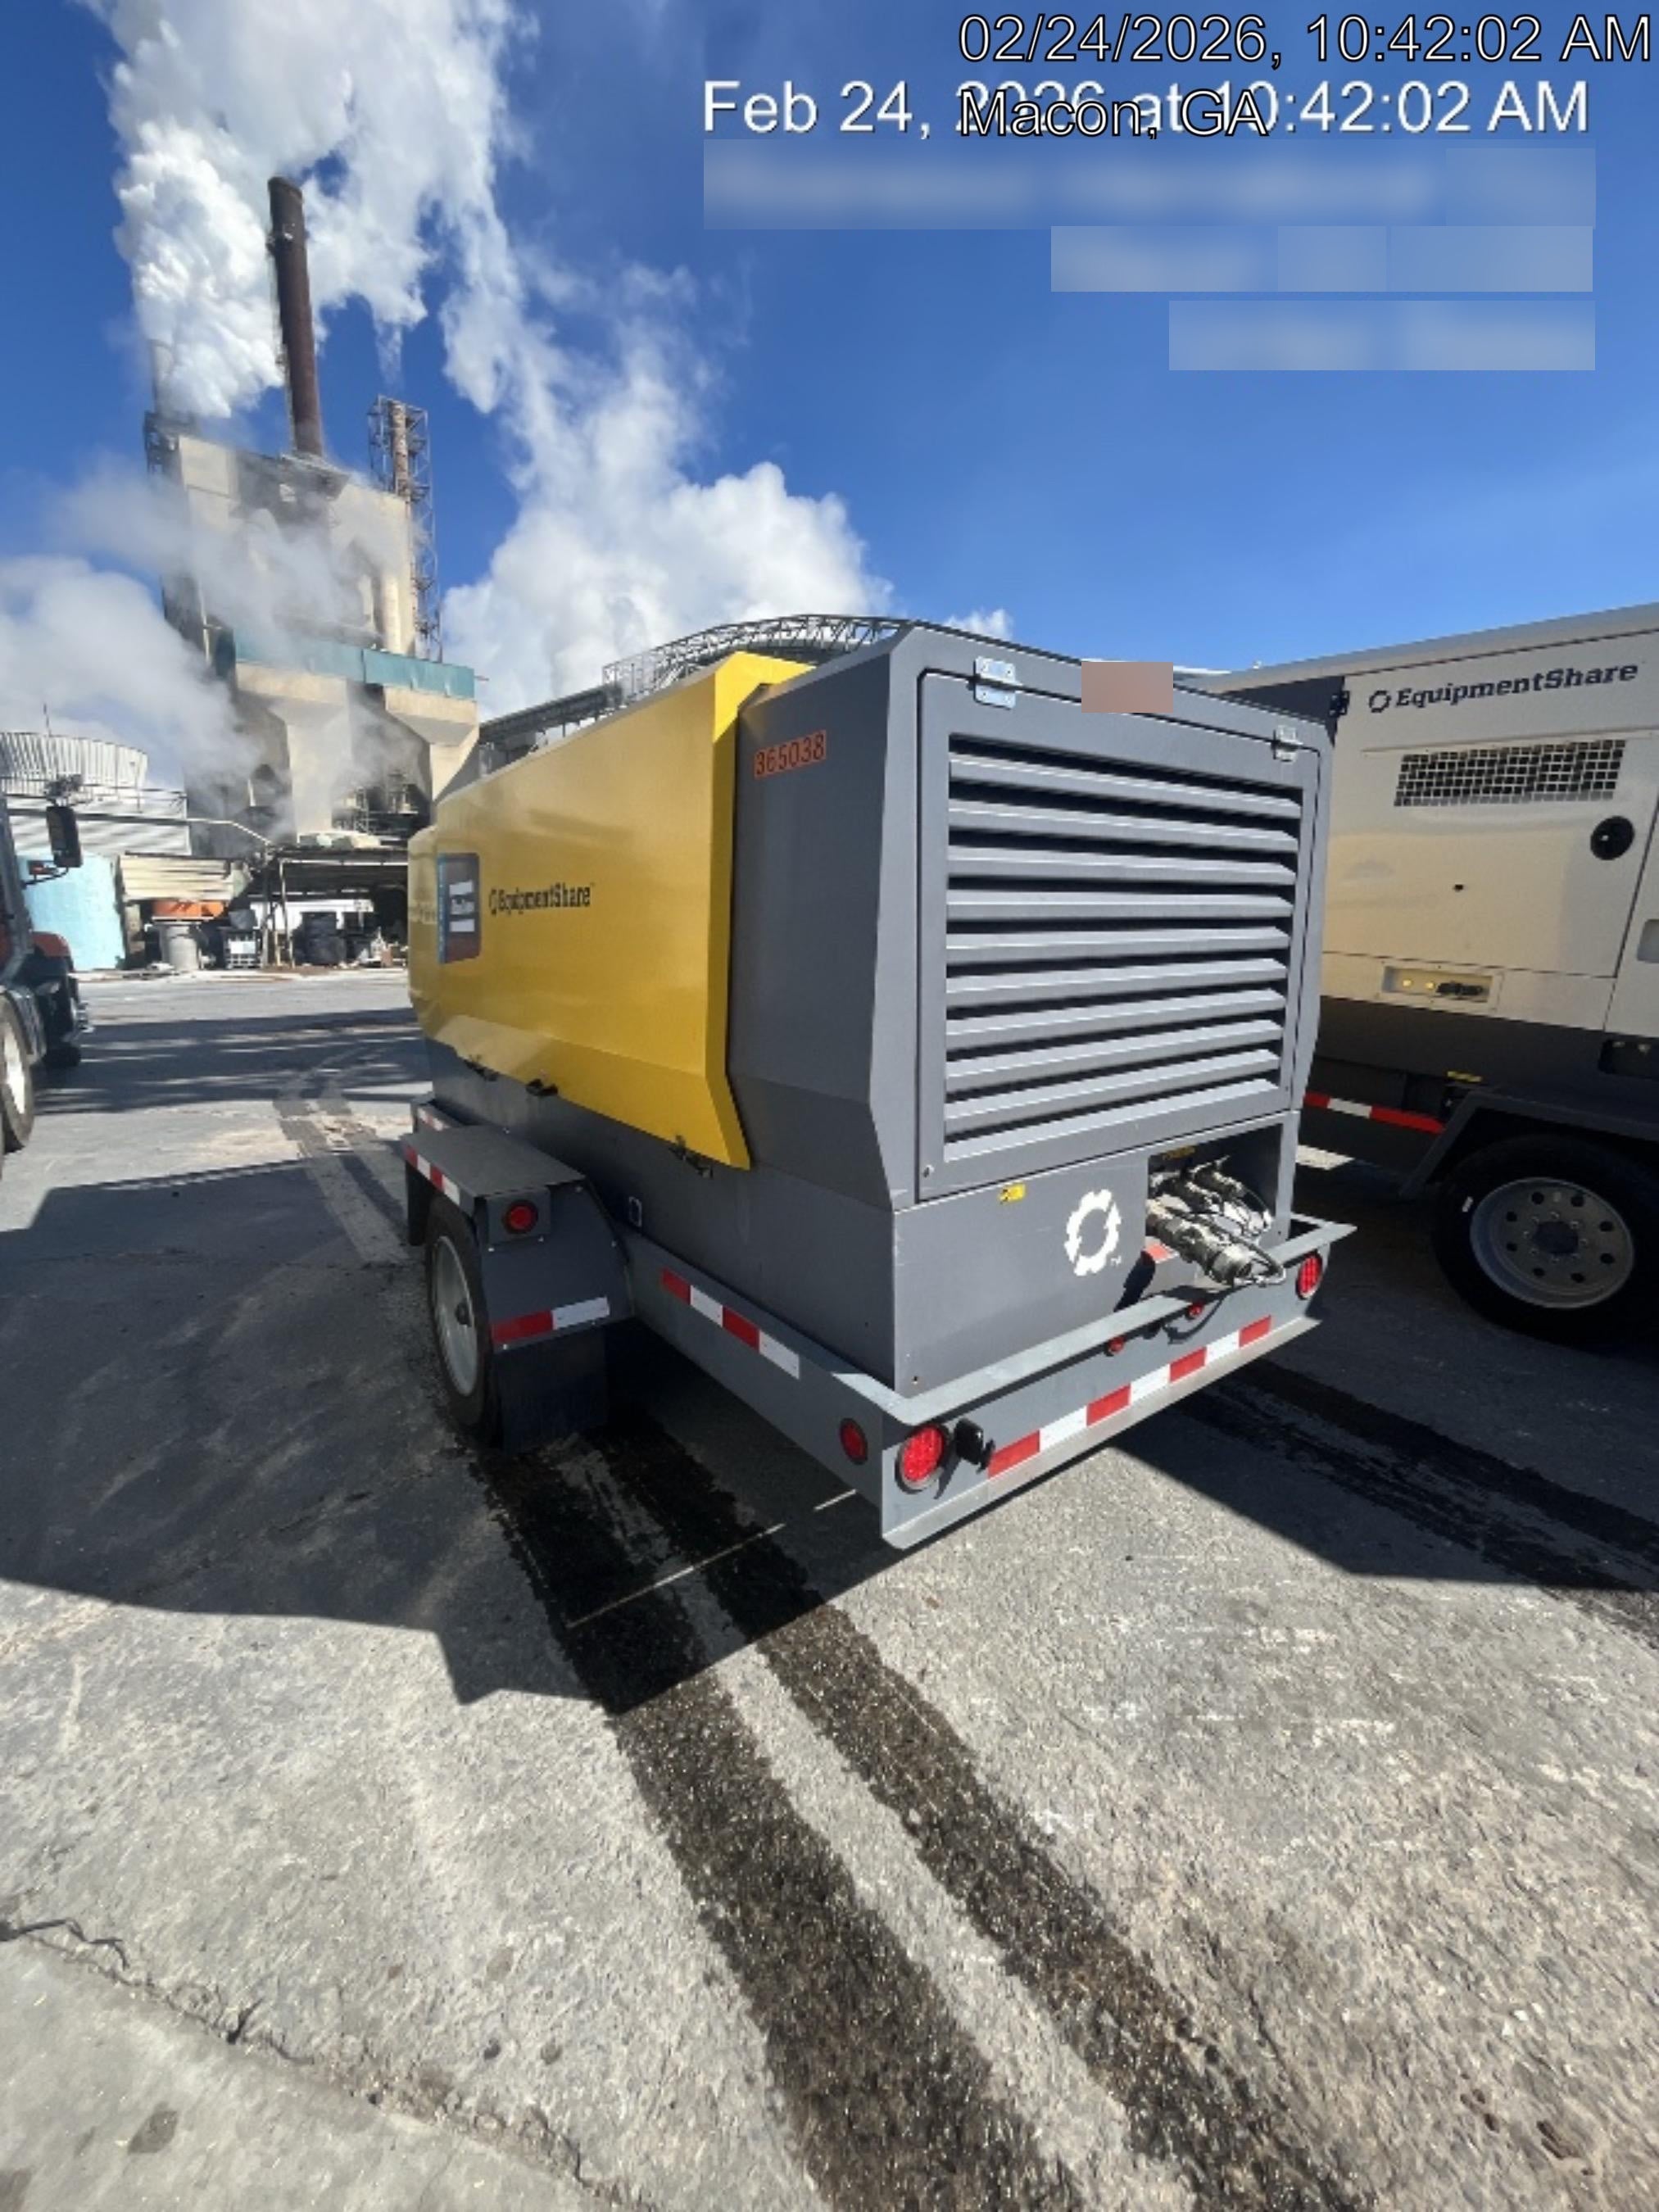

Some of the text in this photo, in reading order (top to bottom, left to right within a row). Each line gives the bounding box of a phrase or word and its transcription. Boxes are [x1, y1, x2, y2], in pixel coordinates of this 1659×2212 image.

[1395, 664, 1639, 709] EquipmentShare
[755, 733, 824, 776] 365038
[498, 882, 591, 915] EquipmentShare
